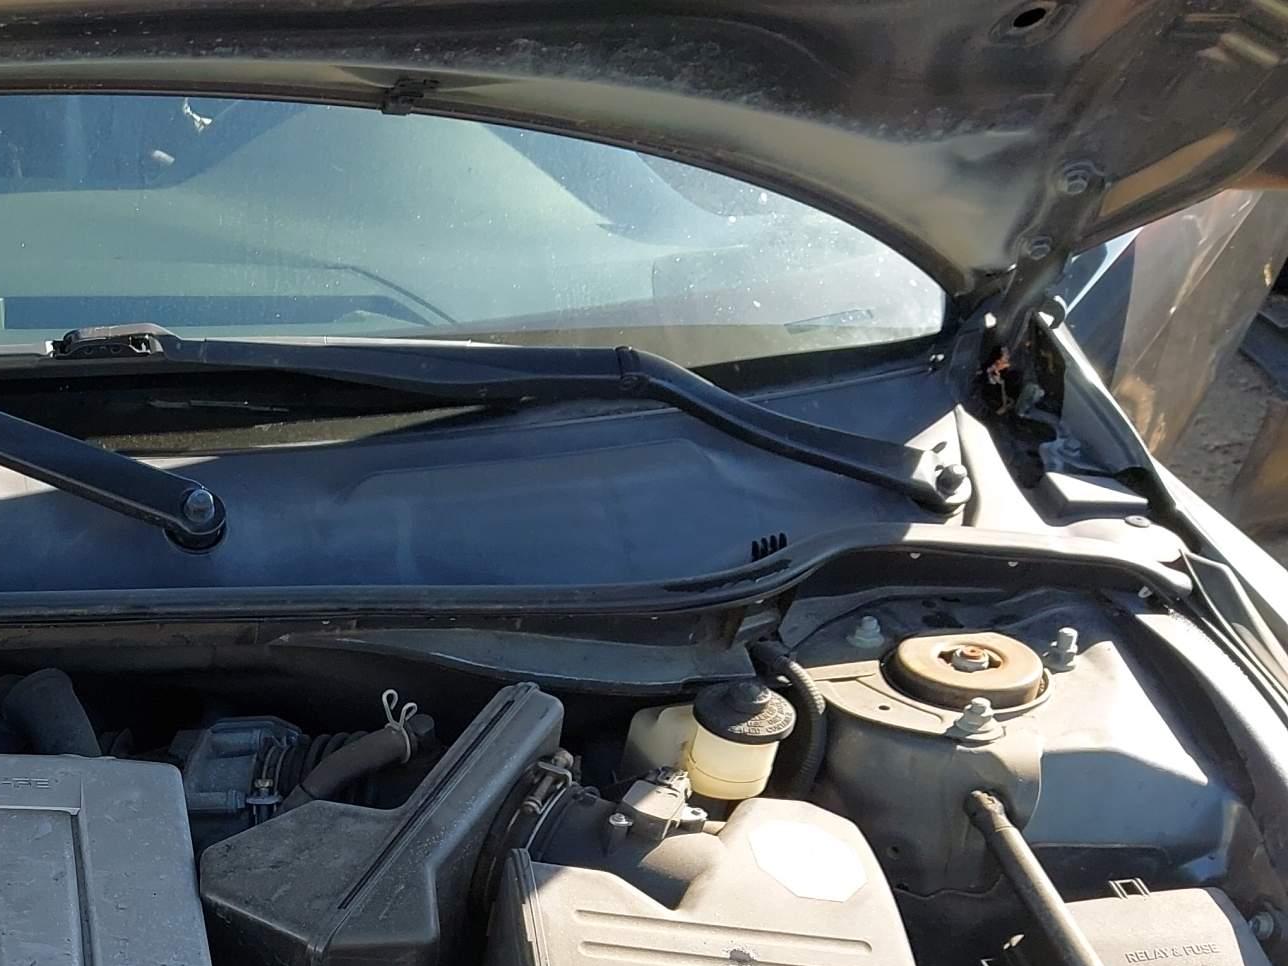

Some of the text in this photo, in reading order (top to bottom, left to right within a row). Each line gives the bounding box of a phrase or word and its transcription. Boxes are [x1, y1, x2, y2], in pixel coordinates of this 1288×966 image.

[1125, 943, 1220, 963] RELAY & FUSE
